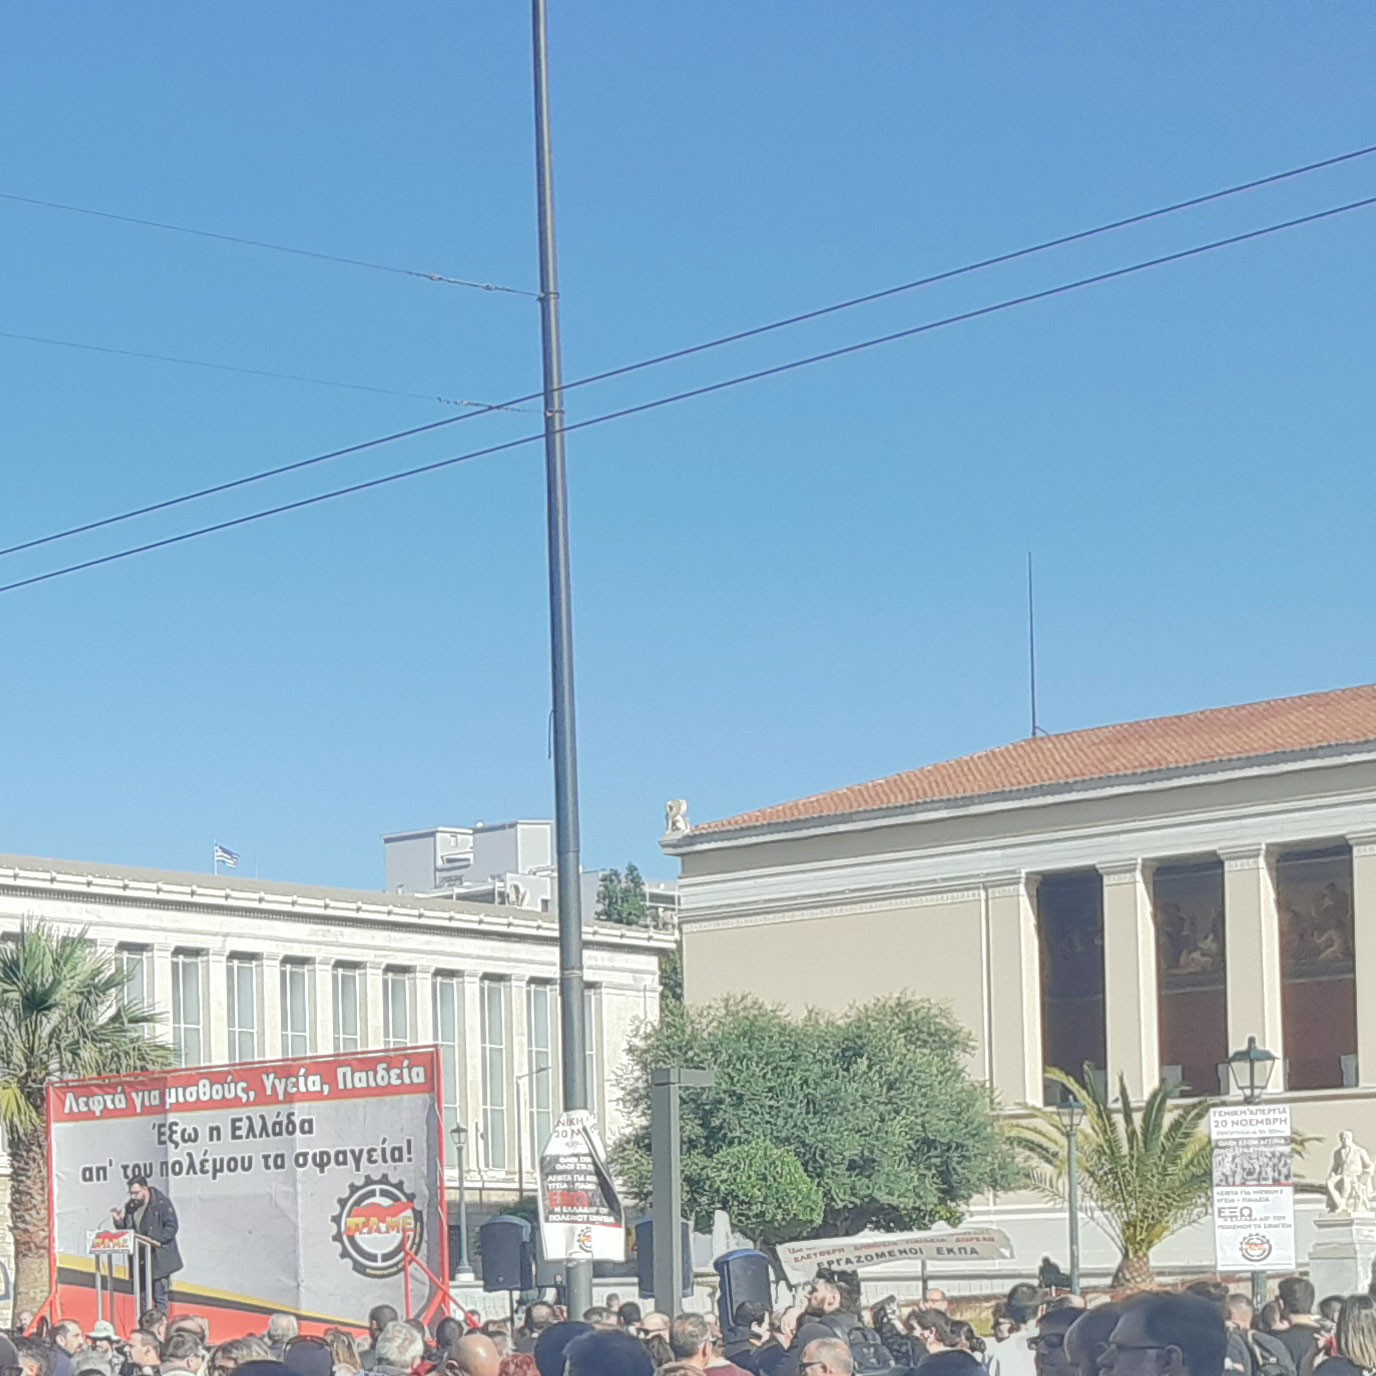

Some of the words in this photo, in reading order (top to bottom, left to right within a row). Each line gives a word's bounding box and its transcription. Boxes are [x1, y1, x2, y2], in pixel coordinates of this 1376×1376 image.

[64, 1086, 127, 1117] Λεφτά
[131, 1088, 160, 1113] για
[165, 1075, 255, 1110] μισθούς,
[262, 1067, 330, 1101] Υγεία,
[336, 1058, 425, 1090] Παιδεία
[152, 1121, 199, 1149] Έξω
[231, 1111, 314, 1140] Ελλάδα
[1213, 1119, 1228, 1128] 20
[1231, 1117, 1287, 1127] ΝΟΕΜΒΡΗ
[81, 1159, 113, 1182] απ'
[121, 1161, 153, 1180] του
[160, 1149, 253, 1180] πολέμου
[262, 1152, 285, 1171] τα
[294, 1137, 413, 1174] σφαγεία!
[1217, 1206, 1253, 1218] ΕΞΩ
[817, 1247, 924, 1268] ΕΡΓΑΖΟΜΕΝΟΙ
[936, 1246, 980, 1256] ΕΚΠΑ
